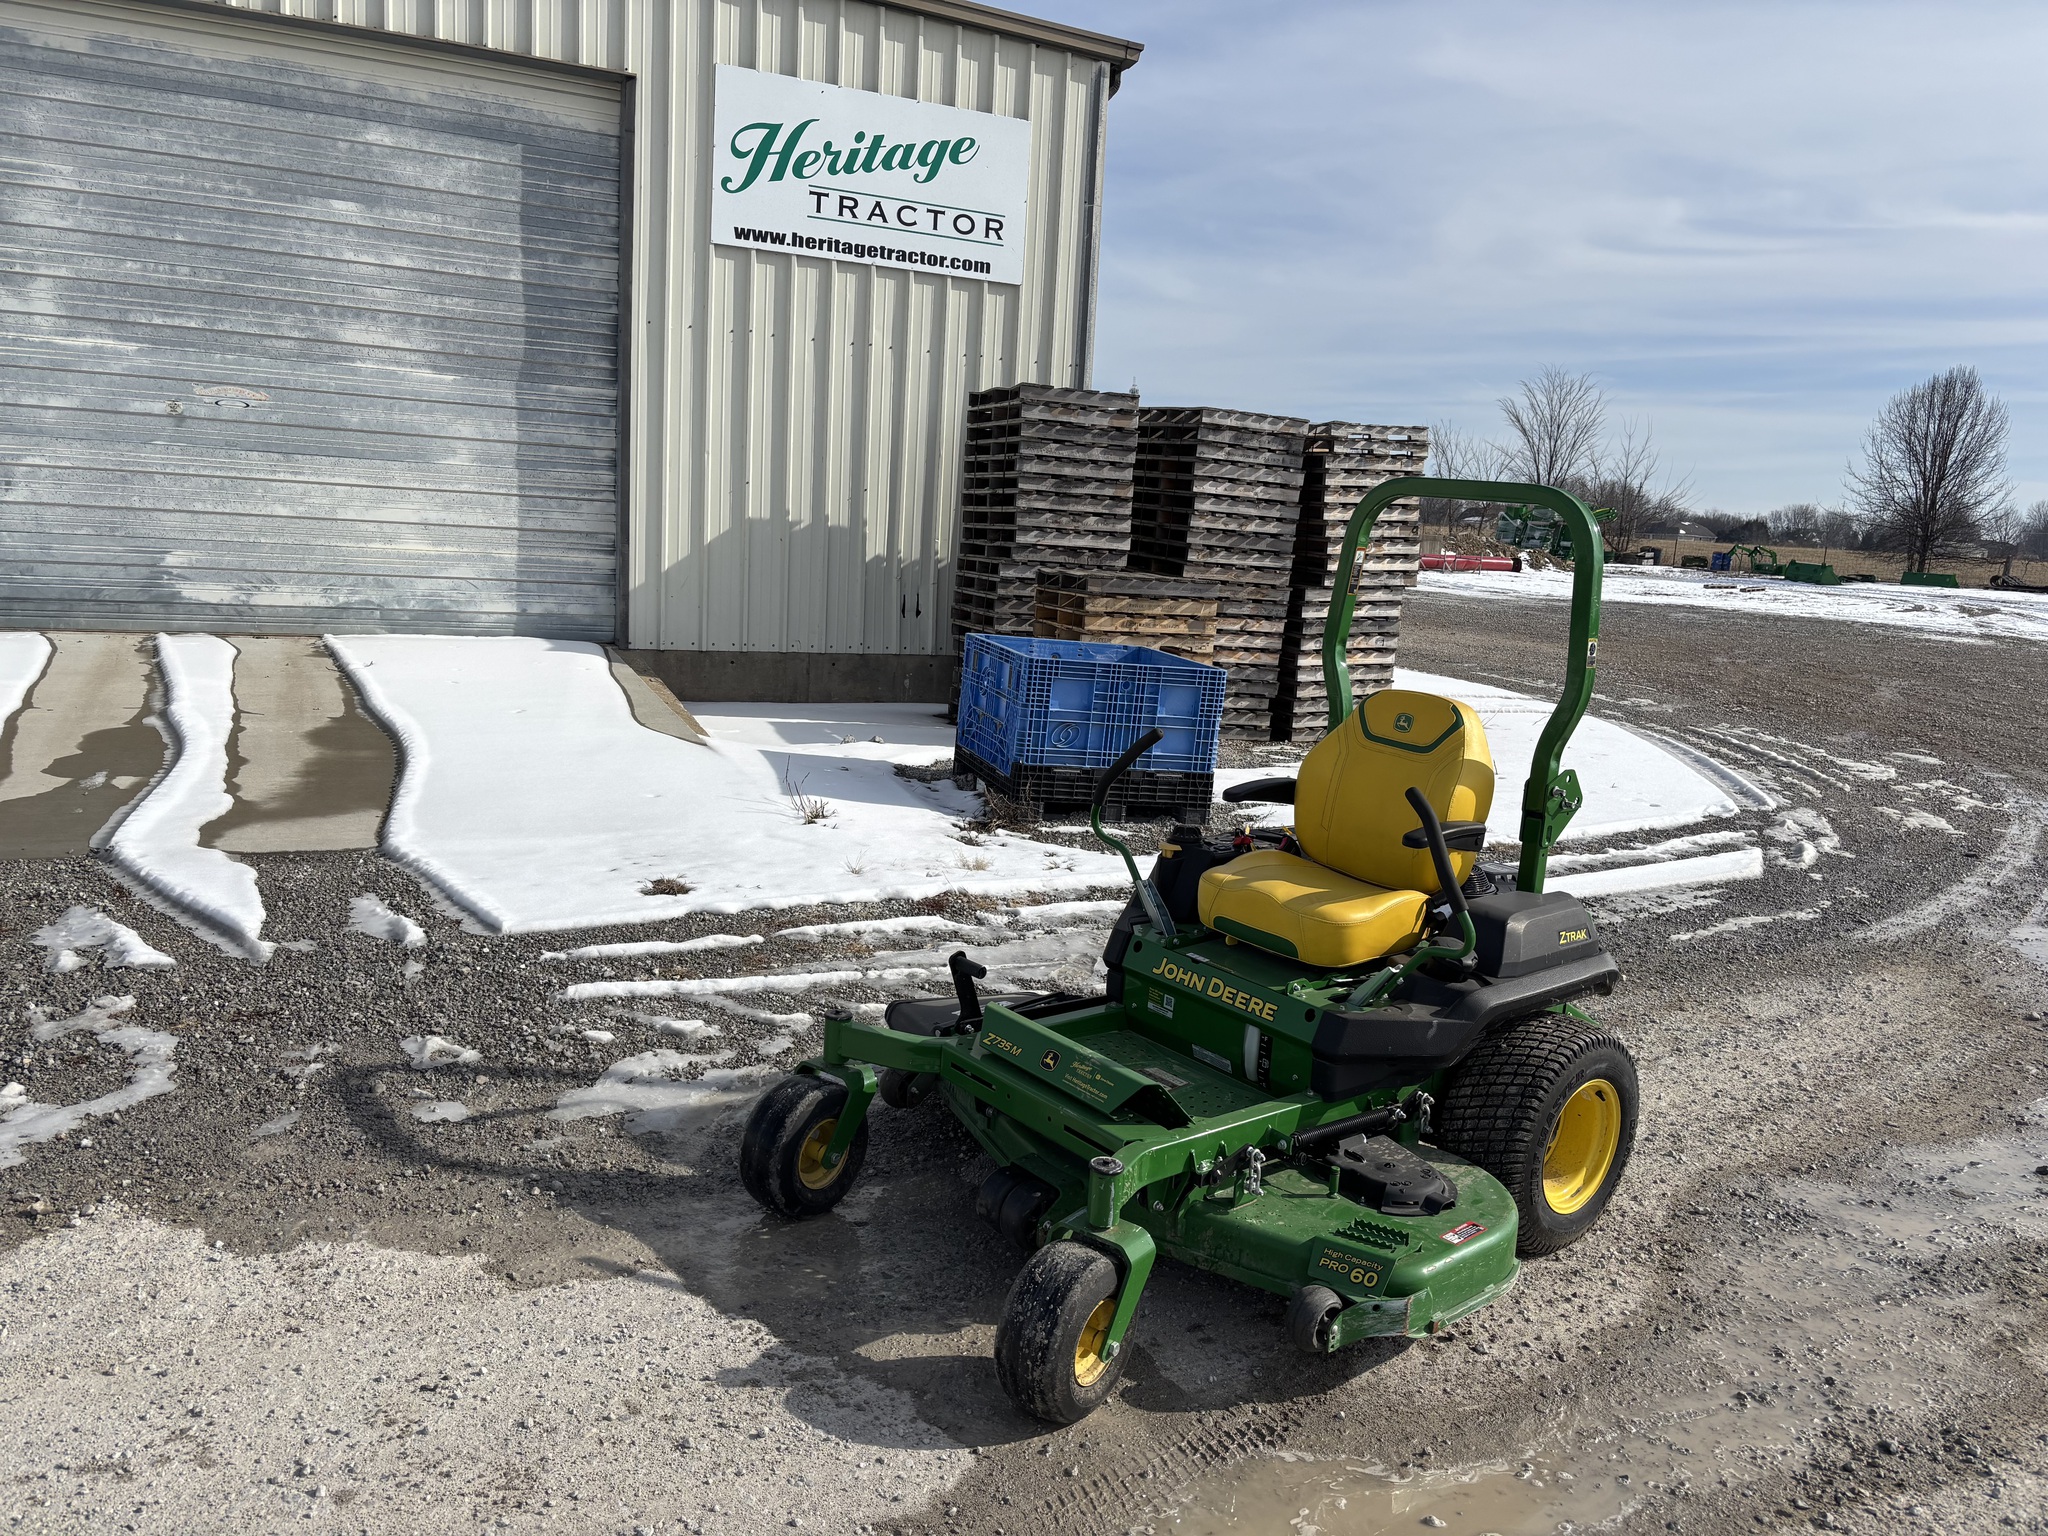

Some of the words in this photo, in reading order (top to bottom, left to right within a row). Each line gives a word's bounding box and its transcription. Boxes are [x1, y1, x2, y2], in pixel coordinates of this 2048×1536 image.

[720, 118, 981, 194] Heritage
[808, 189, 1004, 241] TRACTOR
[733, 226, 991, 274] www.heritagetractor.com
[1559, 928, 1588, 945] ZTRAK
[1152, 957, 1206, 992] JOHN
[1206, 977, 1278, 1022] DEERE
[1537, 1069, 1585, 1149] MASTER
[1319, 1257, 1349, 1273] PRO
[1350, 1268, 1378, 1287] 60
[1323, 1248, 1343, 1258] High
[1344, 1254, 1384, 1271] Capacity
